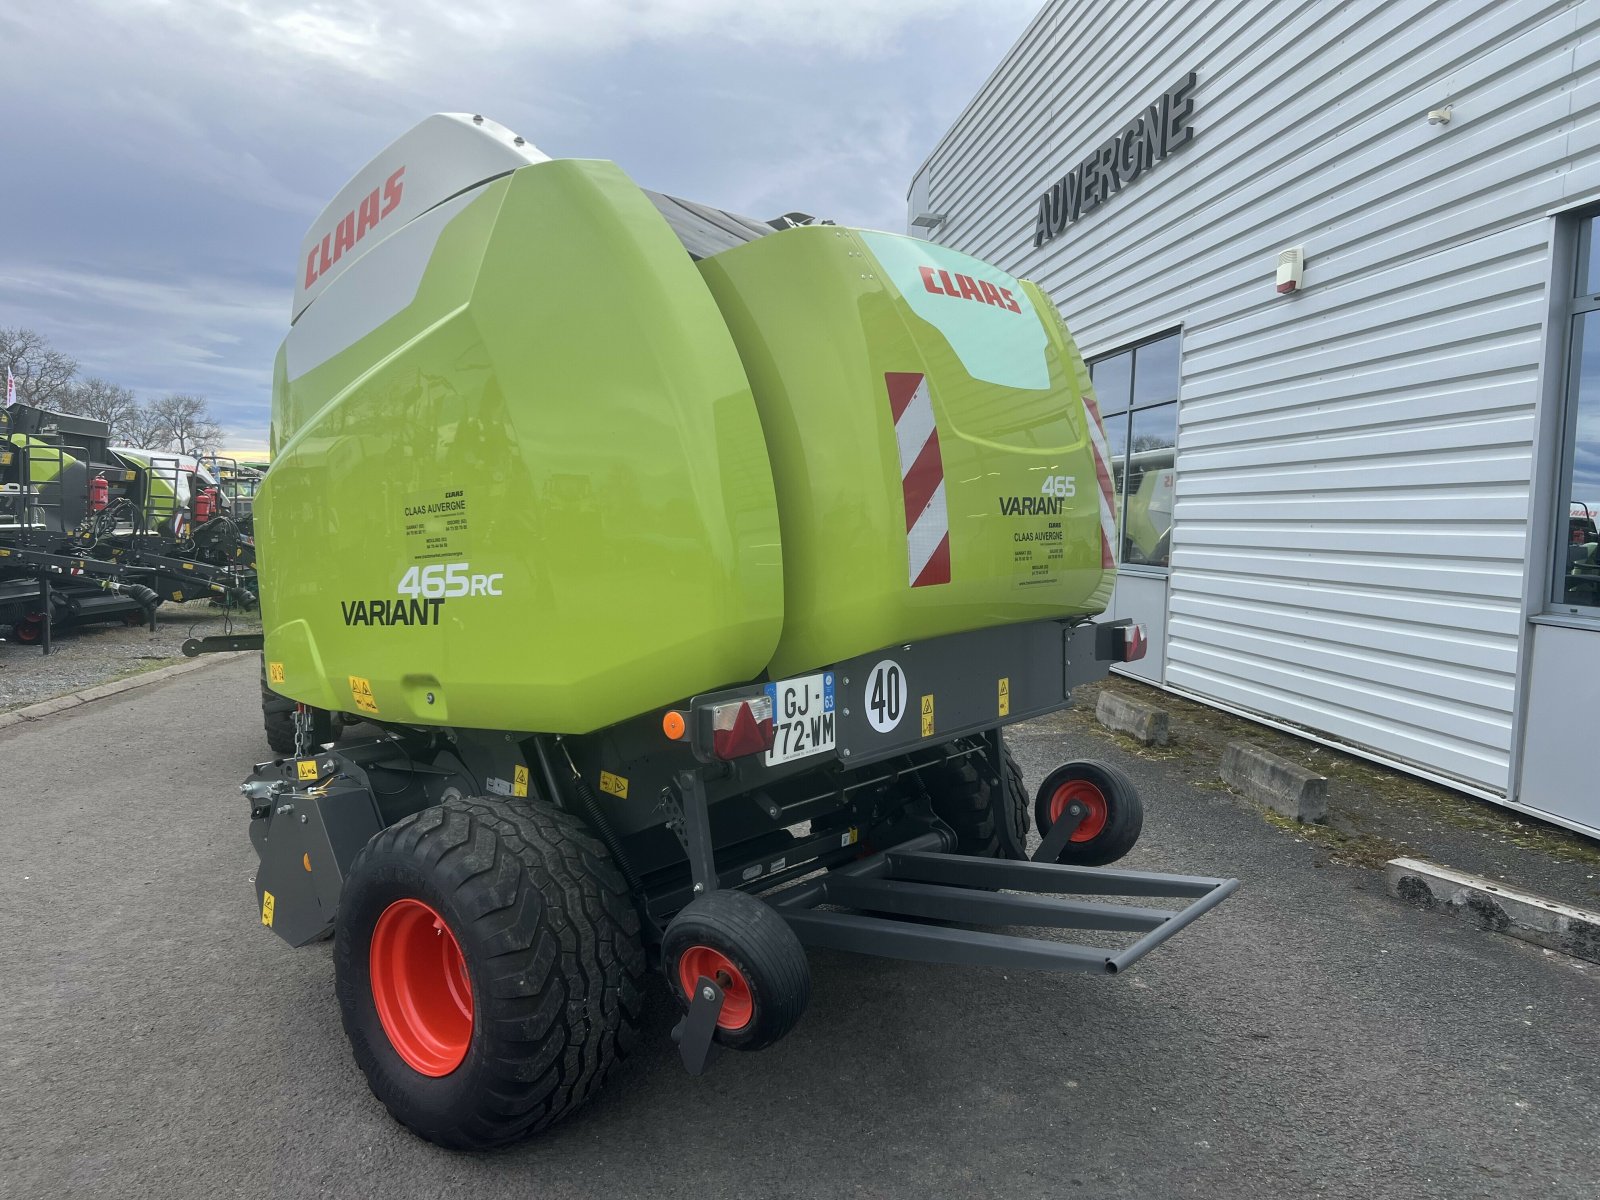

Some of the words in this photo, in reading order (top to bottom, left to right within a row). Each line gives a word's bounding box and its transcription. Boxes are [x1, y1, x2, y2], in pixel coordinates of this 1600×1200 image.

[1033, 72, 1196, 247] AUVERGNE
[304, 165, 406, 290] CLAAS
[918, 266, 1022, 315] CLAAS
[1041, 475, 1076, 497] 465
[404, 506, 427, 517] CLAAS
[427, 500, 466, 514] AUVERGNE
[999, 496, 1065, 516] VARIANT
[1014, 532, 1034, 542] CLAAS
[1034, 531, 1063, 541] AUVERGNE
[341, 597, 446, 626] VARIANT
[825, 694, 834, 709] 63
[870, 665, 900, 724] 40
